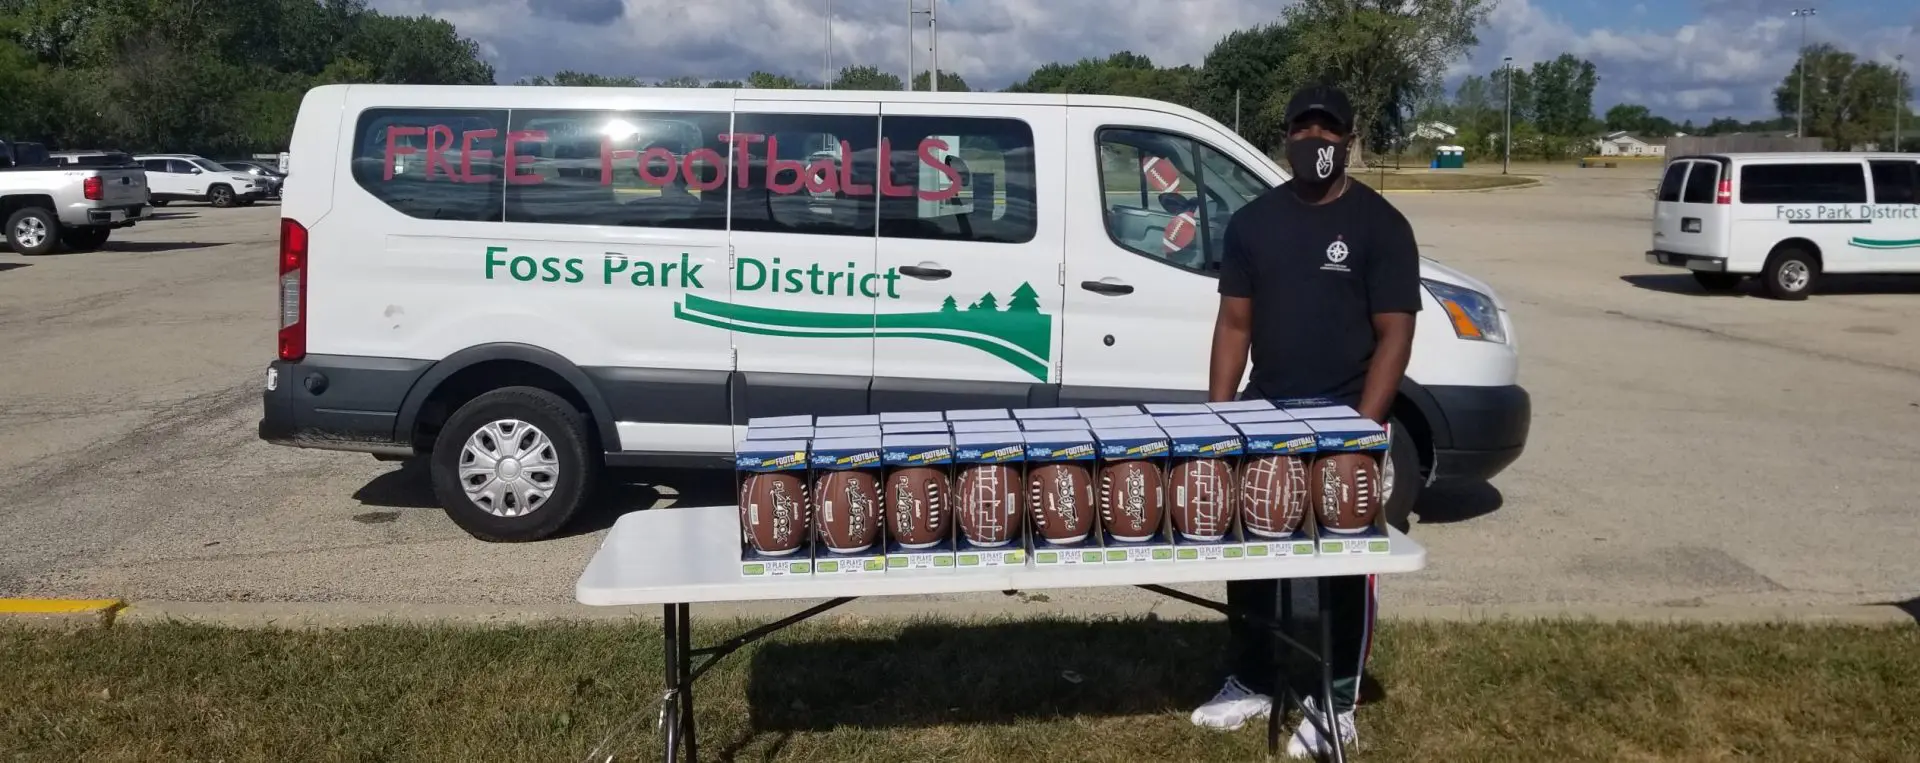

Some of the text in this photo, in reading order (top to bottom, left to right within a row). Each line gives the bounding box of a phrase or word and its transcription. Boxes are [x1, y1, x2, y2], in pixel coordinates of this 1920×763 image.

[383, 125, 548, 185] FREE
[1776, 204, 1918, 219] Foss Park District
[484, 246, 901, 299] Foss Park District
[1212, 437, 1241, 451] FOOTBALL
[1286, 435, 1315, 449] FOOTBALL
[1357, 432, 1387, 446] FOOTBALL
[994, 445, 1022, 457] FOOTBALL
[1065, 443, 1093, 455] FOOTBALL
[1140, 440, 1168, 453] FOOTBALL
[850, 451, 878, 463] FOOTBALL
[922, 448, 949, 460] FOOTBALL
